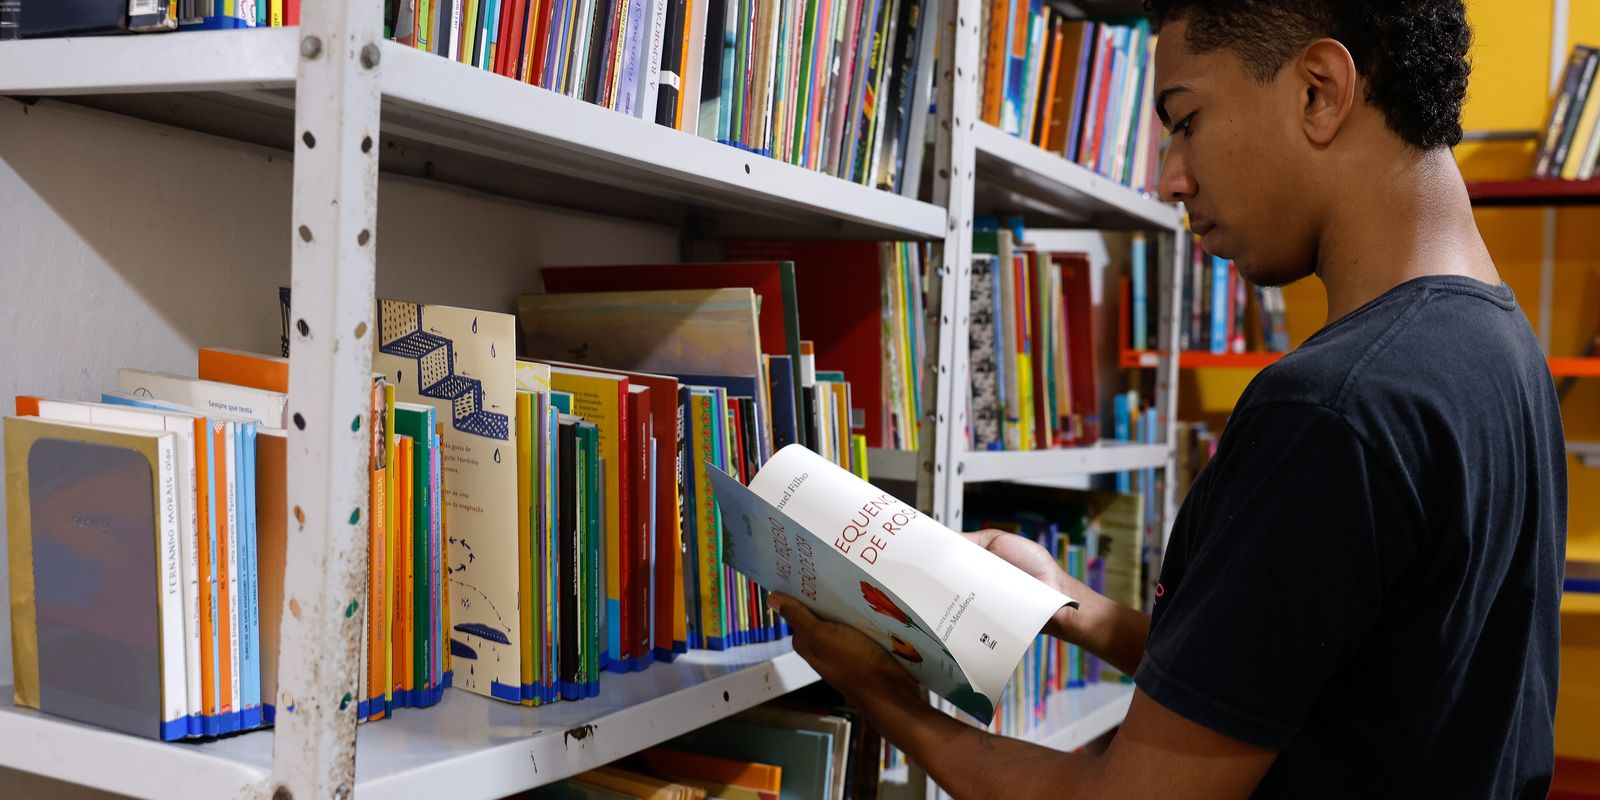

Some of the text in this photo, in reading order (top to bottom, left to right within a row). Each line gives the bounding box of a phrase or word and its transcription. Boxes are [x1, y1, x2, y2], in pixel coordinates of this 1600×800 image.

[650, 82, 655, 90] A
[208, 400, 252, 414] Sempre que tenta
[788, 472, 809, 492] Filho
[167, 476, 175, 524] MORAIS
[168, 528, 177, 595] FERNANDO
[860, 535, 888, 565] DE
[950, 592, 976, 626] Mendonça
